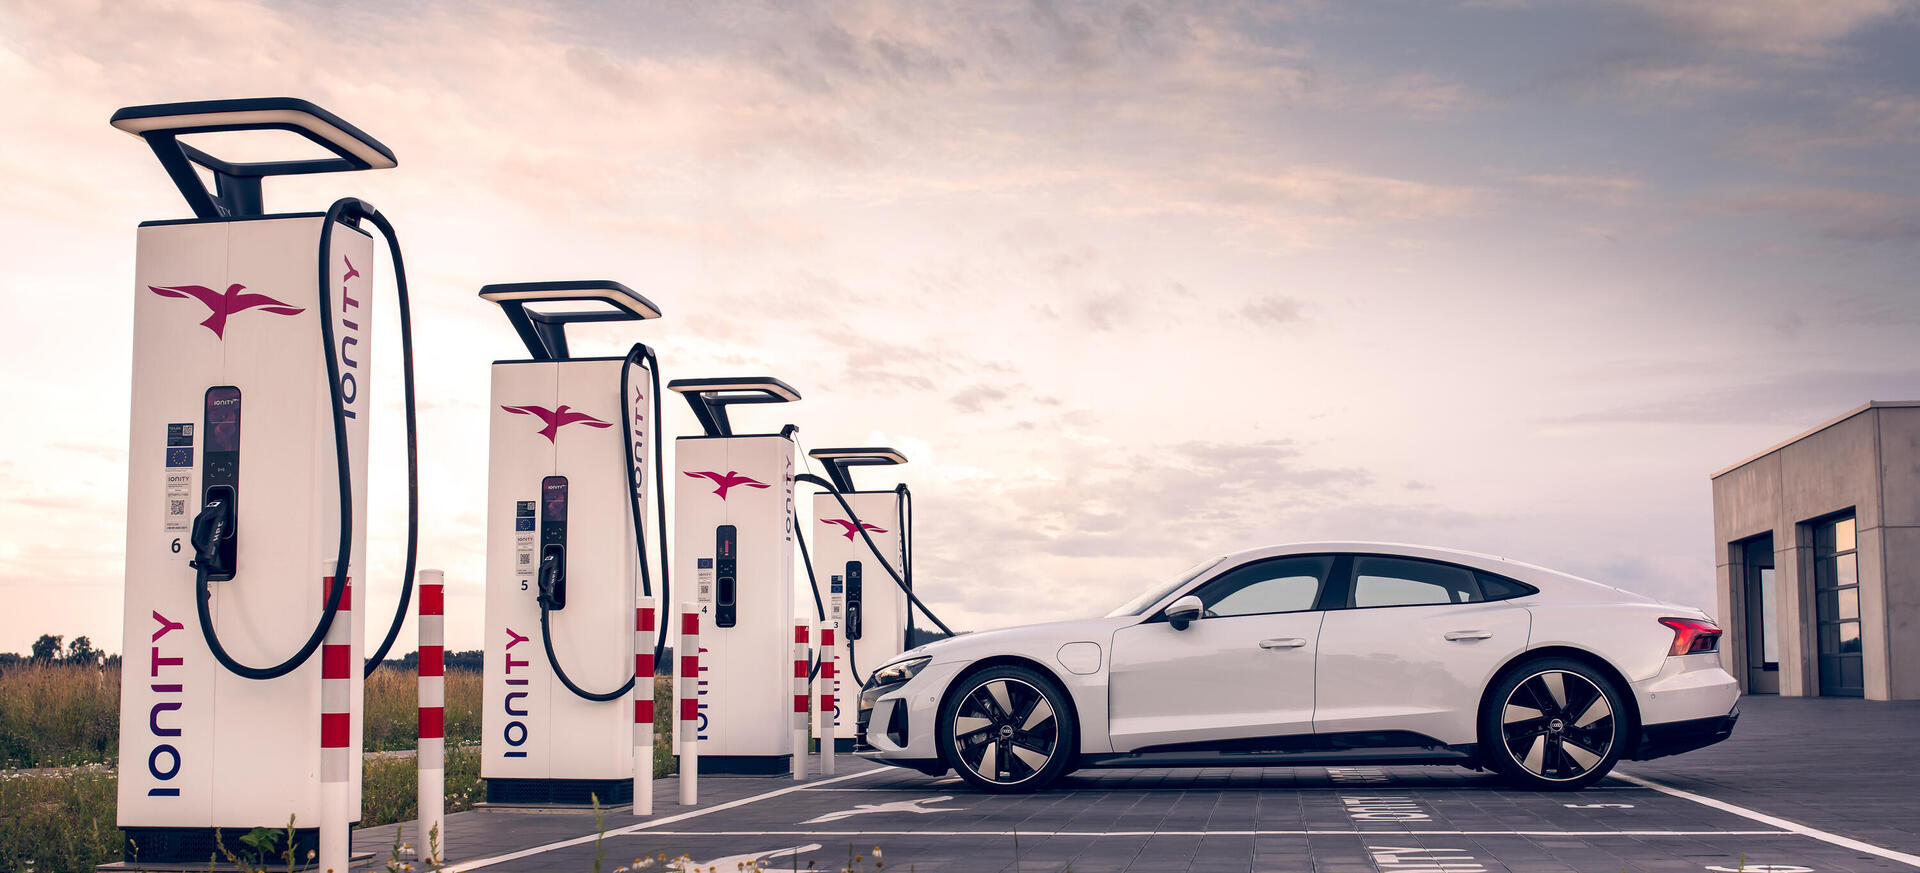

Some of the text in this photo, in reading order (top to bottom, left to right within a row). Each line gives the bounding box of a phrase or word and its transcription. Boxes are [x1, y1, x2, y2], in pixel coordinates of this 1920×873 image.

[340, 254, 360, 420] IONITY
[634, 384, 644, 499] IONITY
[171, 538, 182, 554] 6
[520, 580, 529, 591] 5
[701, 605, 708, 614] 4
[148, 610, 184, 796] IONITY
[504, 628, 530, 757] IONITY
